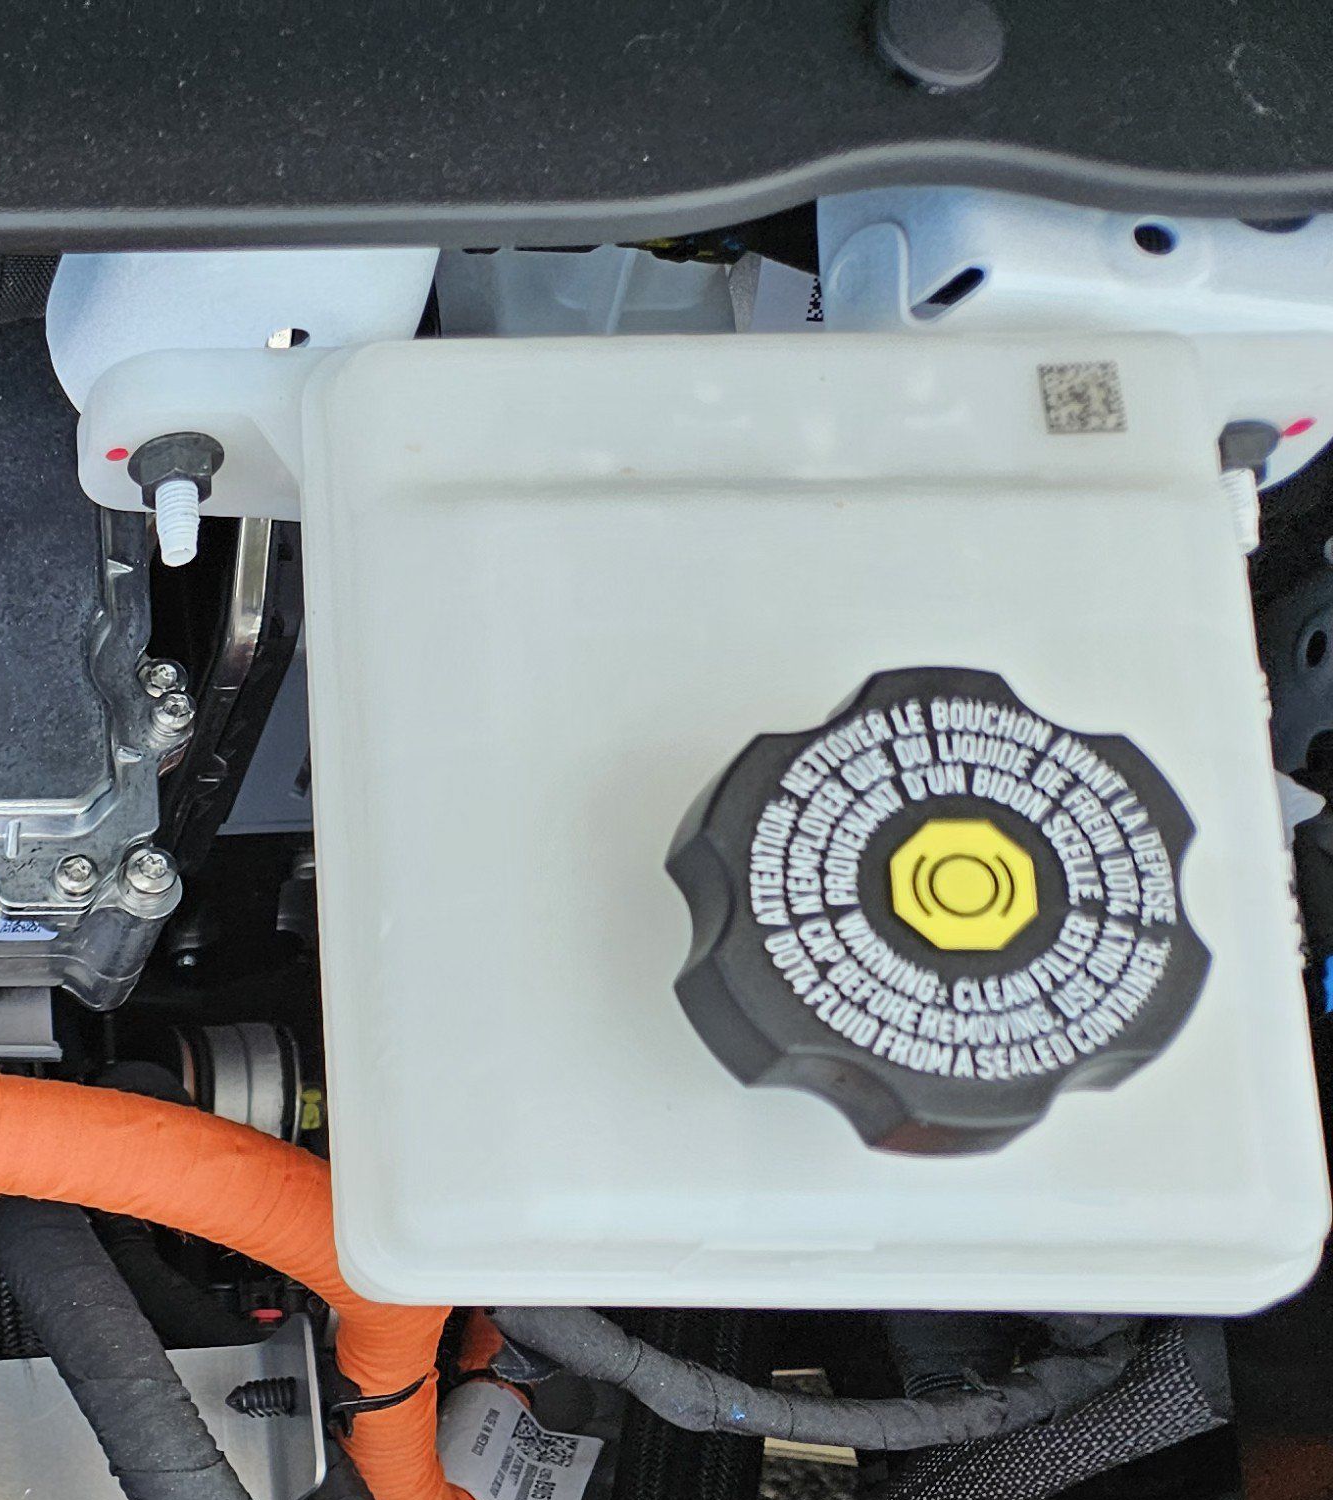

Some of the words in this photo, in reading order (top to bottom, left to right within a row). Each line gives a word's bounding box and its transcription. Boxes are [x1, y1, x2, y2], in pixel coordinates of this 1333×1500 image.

[780, 710, 893, 798] NETTOYER
[890, 702, 927, 735] LE
[931, 697, 1053, 751] BOUCHON
[1047, 733, 1129, 799] AVANT
[1109, 792, 1148, 832] LA
[841, 745, 896, 790] QUE
[893, 735, 932, 769] DU
[937, 732, 1035, 779] LIQUIDE
[1033, 758, 1073, 798] DE
[1062, 785, 1125, 854] FREIN
[824, 780, 904, 906] PROVENANT
[901, 763, 968, 800] D'UN
[973, 767, 1053, 823] BIDON
[799, 917, 846, 962] CAP
[827, 958, 922, 1033] BEFORE
[1051, 971, 1105, 1019] USE
[1087, 919, 1135, 984] ONLY
[835, 910, 948, 1005] WARNING:
[953, 970, 1041, 1012] CLEAN
[1029, 914, 1099, 992] FILLER
[804, 982, 880, 1047] FLUID
[873, 1026, 953, 1077] FROM
[953, 1045, 974, 1078] A
[975, 1033, 1075, 1080] SEALED
